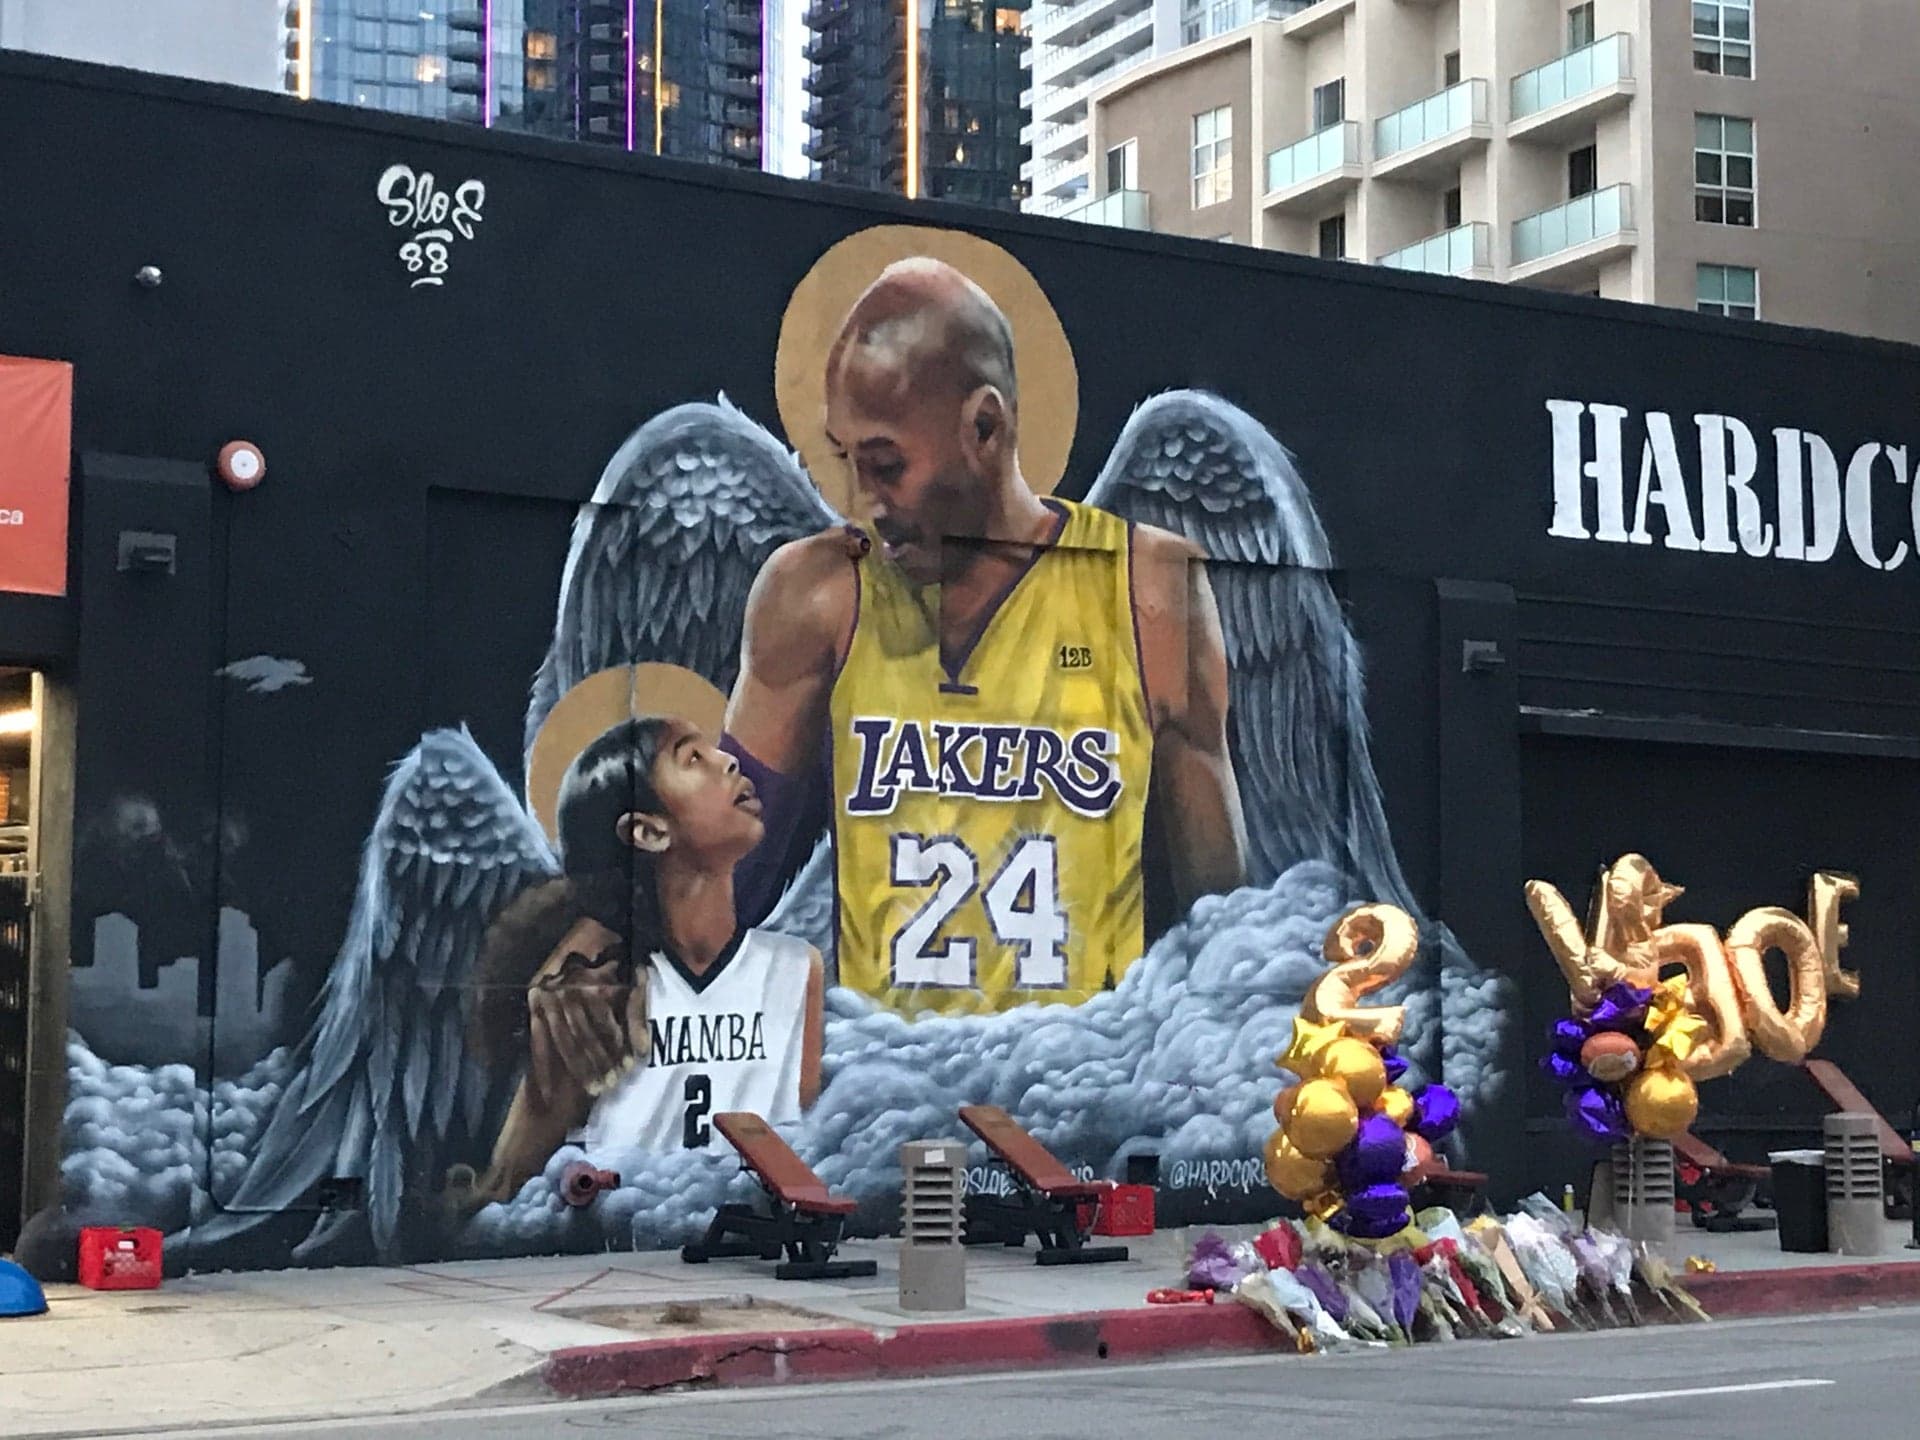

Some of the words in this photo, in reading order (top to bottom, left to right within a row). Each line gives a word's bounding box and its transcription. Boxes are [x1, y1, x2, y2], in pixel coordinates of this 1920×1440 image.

[399, 242, 449, 274] 88
[1546, 399, 1920, 571] HARDC
[1060, 646, 1092, 668] 12B
[848, 717, 1122, 818] LAKERS
[890, 833, 1068, 989] 24
[648, 1012, 767, 1068] MAMBA
[683, 1074, 711, 1149] 2
